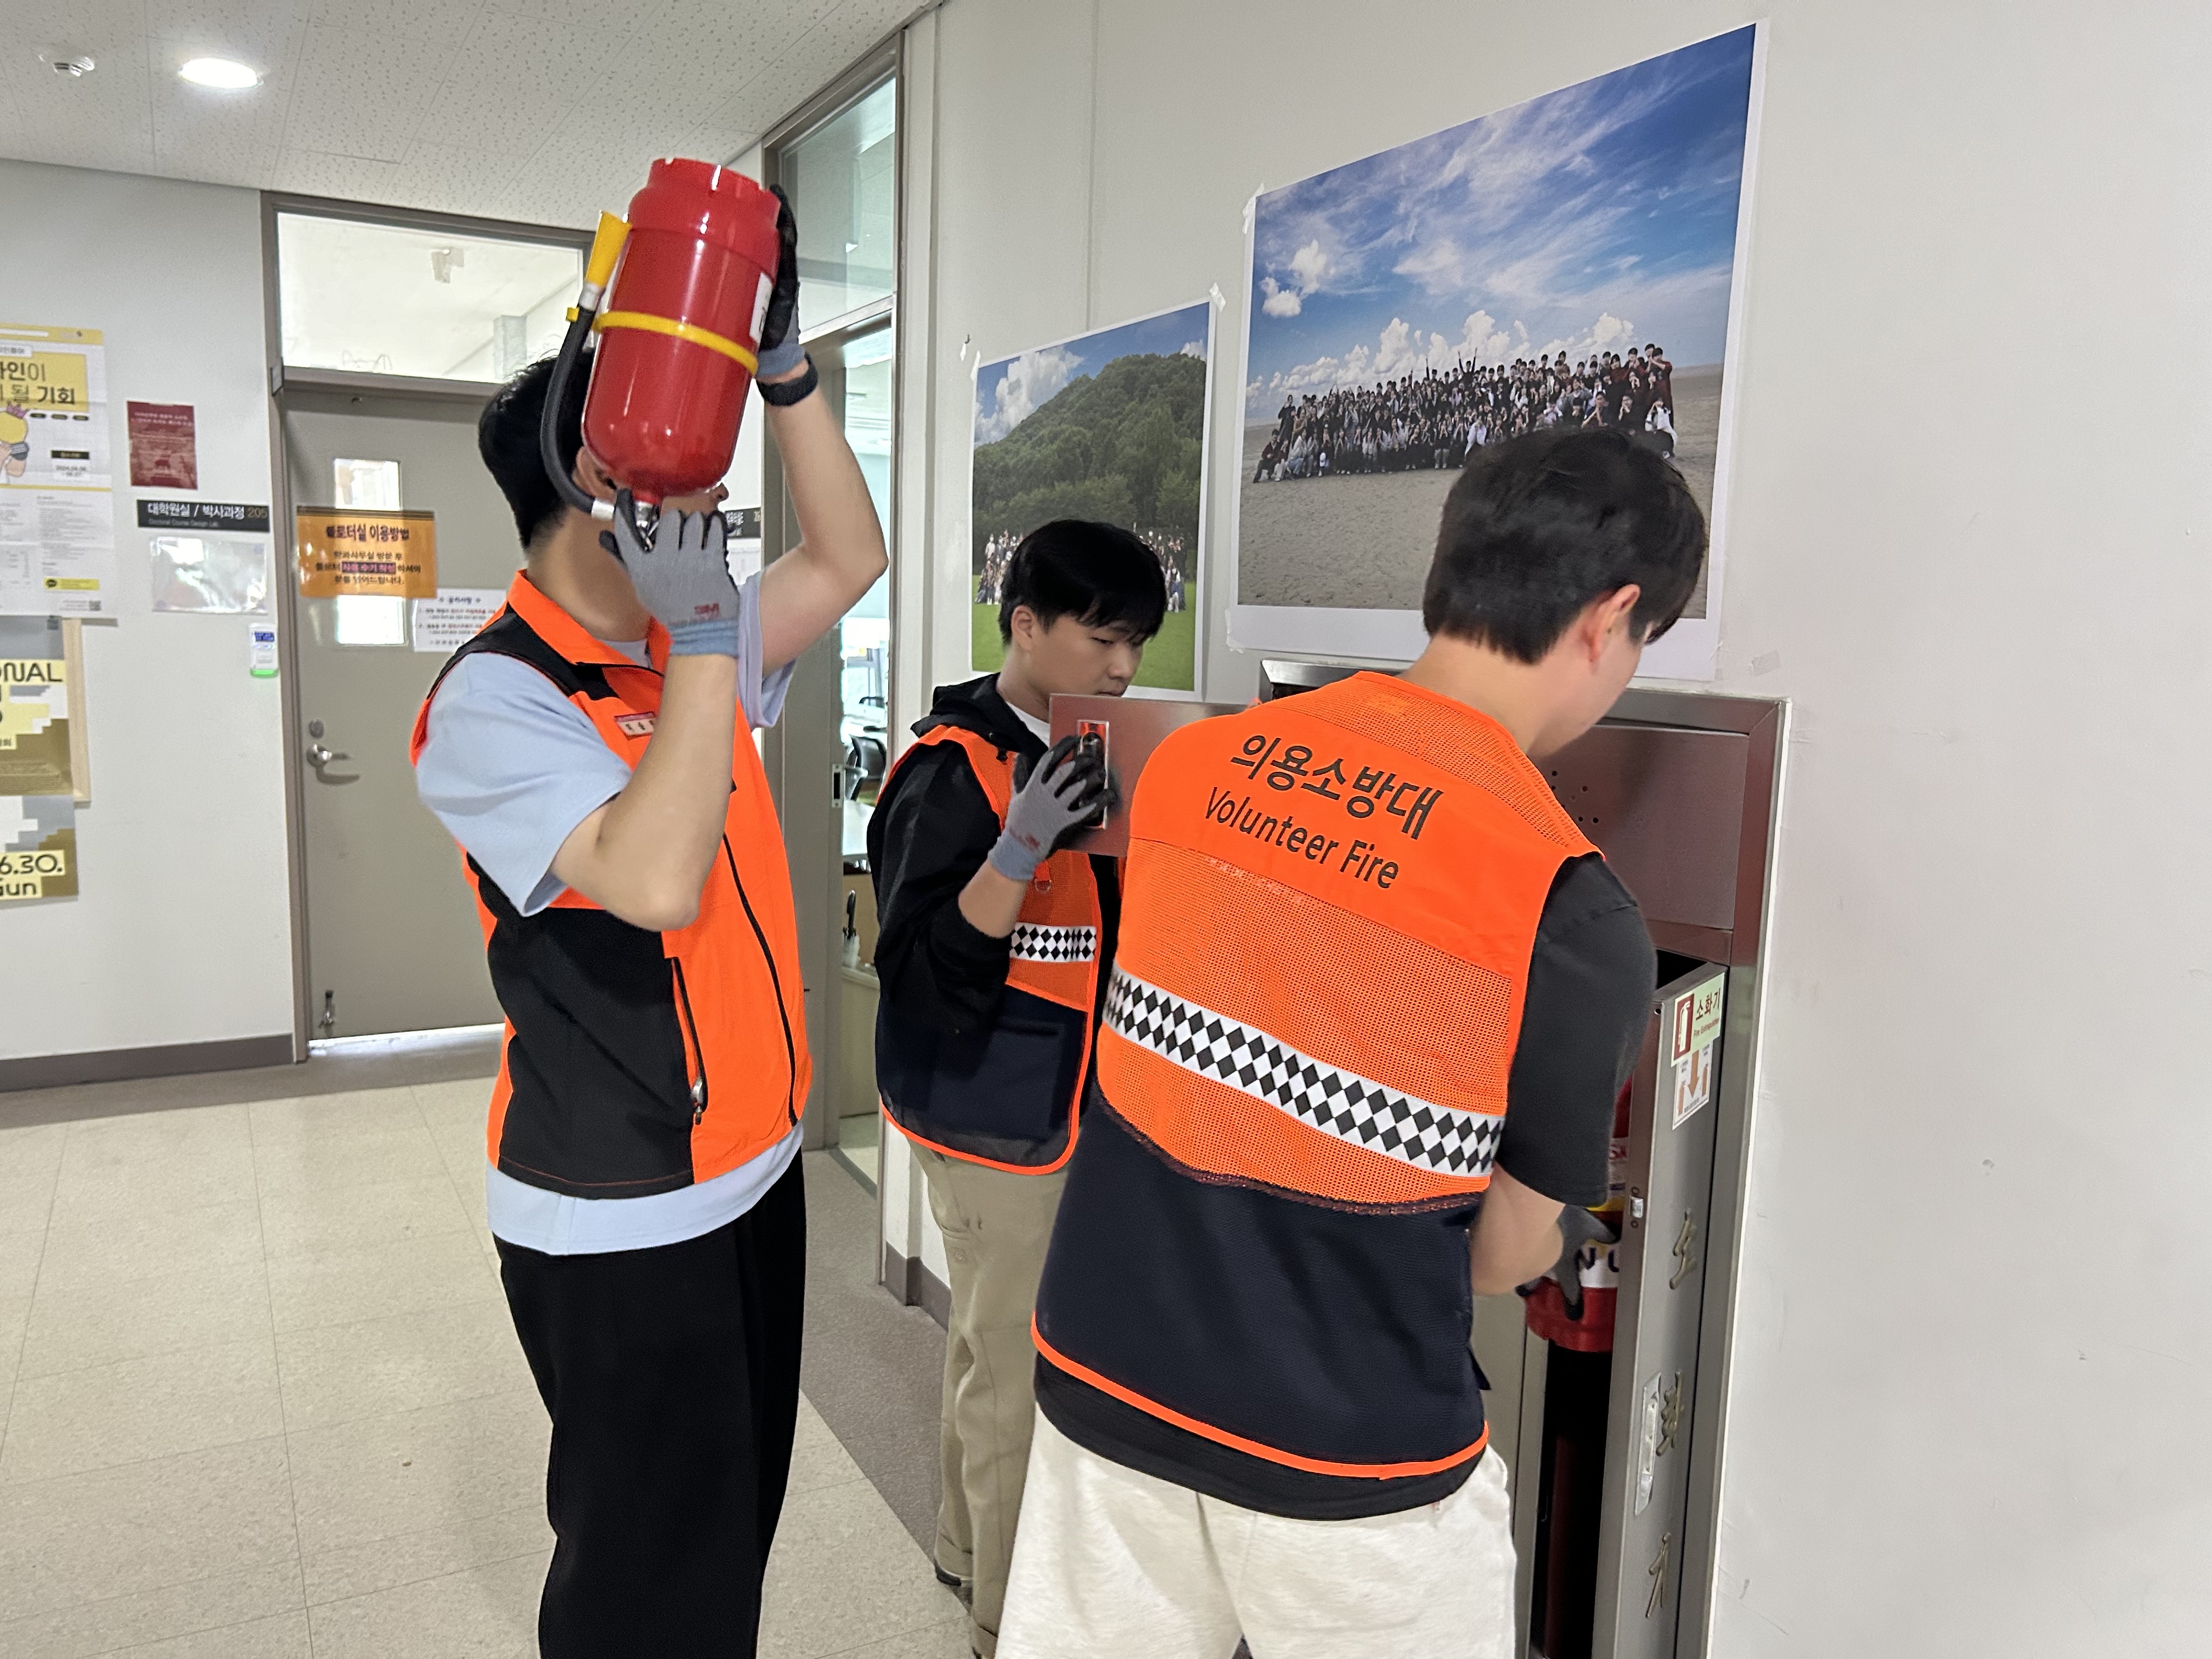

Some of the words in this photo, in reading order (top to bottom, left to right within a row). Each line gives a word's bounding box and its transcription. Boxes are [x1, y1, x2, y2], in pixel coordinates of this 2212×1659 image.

[37, 386, 75, 405] 기회
[147, 501, 190, 517] 대학원실
[202, 504, 245, 520] 박사과정
[369, 524, 409, 542] 이용방법
[0, 662, 63, 682] NAL
[1229, 735, 1444, 840] 의용소방대
[1205, 786, 1339, 865] Volunteer
[1339, 839, 1400, 889] Fire
[1695, 988, 1721, 1020] 소화기
